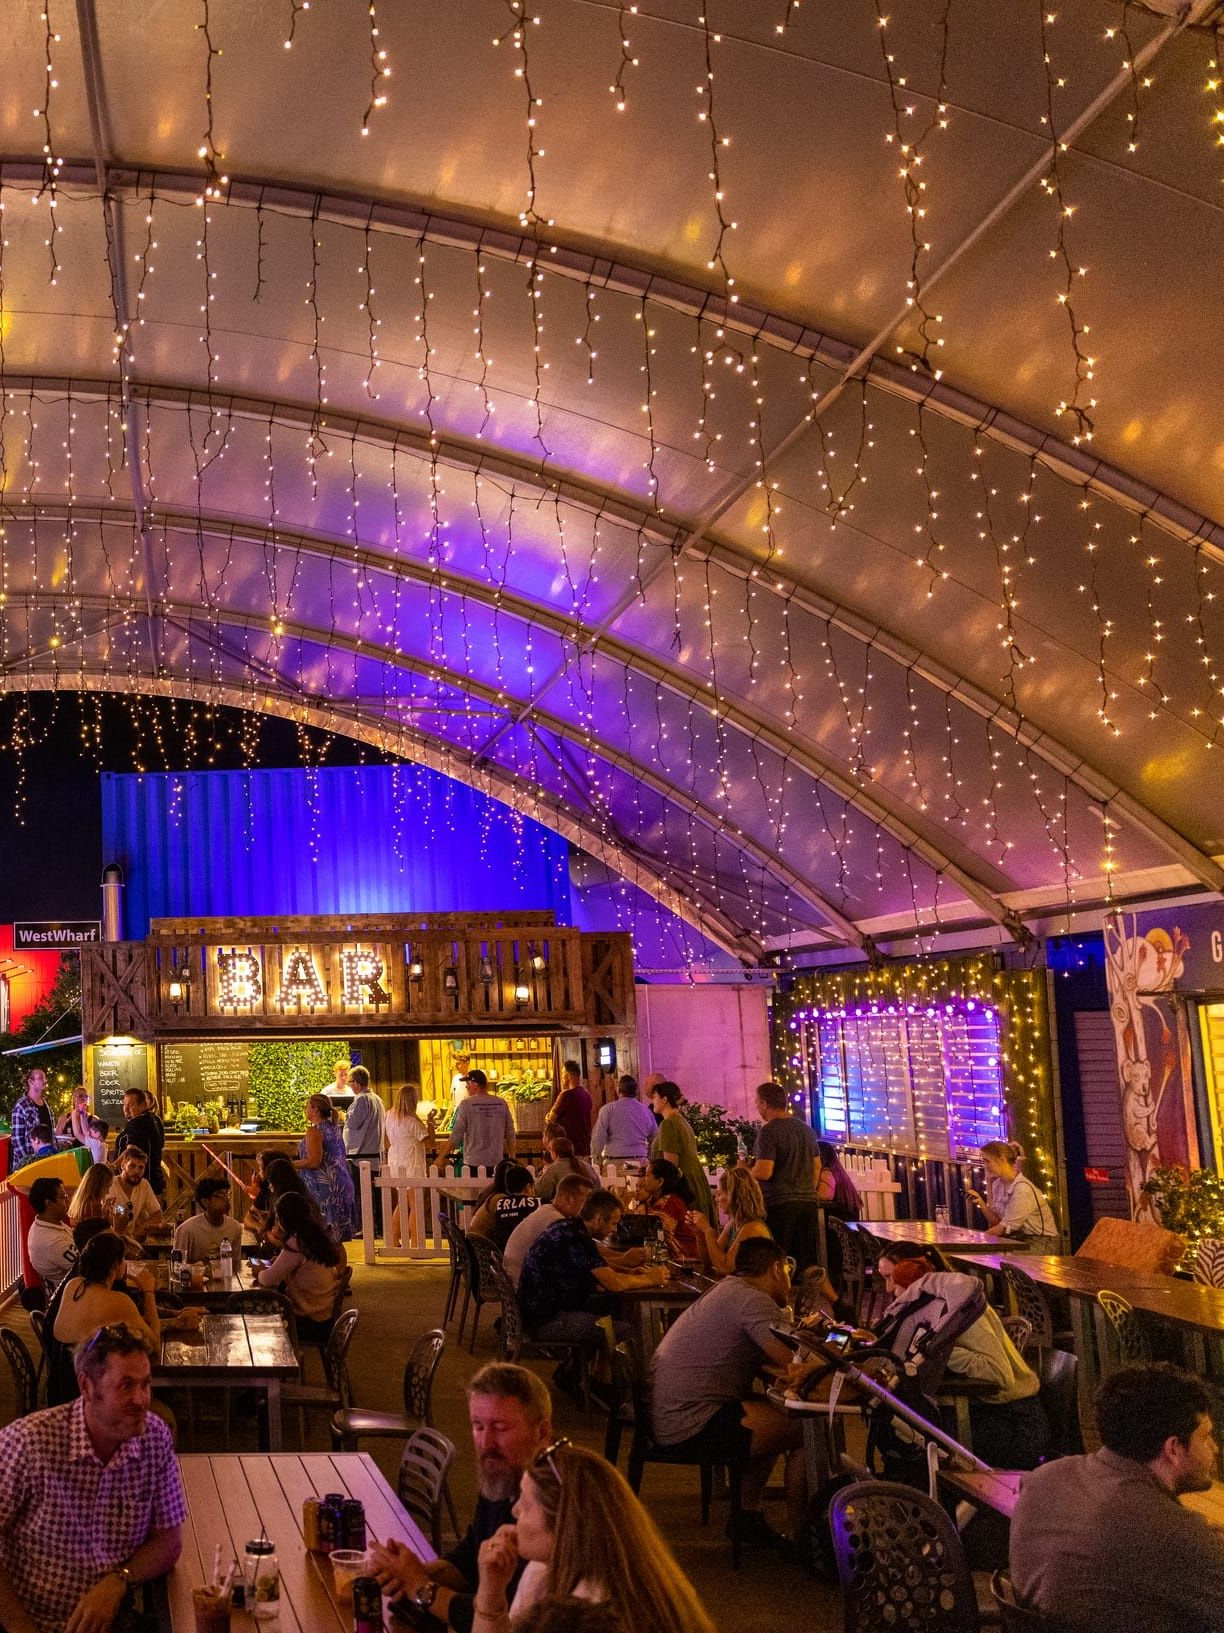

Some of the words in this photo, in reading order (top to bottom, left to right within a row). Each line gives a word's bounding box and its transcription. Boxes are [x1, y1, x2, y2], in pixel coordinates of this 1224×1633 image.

[19, 929, 97, 943] WestWharf
[217, 950, 391, 1007] BAR
[99, 1069, 119, 1077] BEER
[496, 1196, 542, 1211] ERLAST
